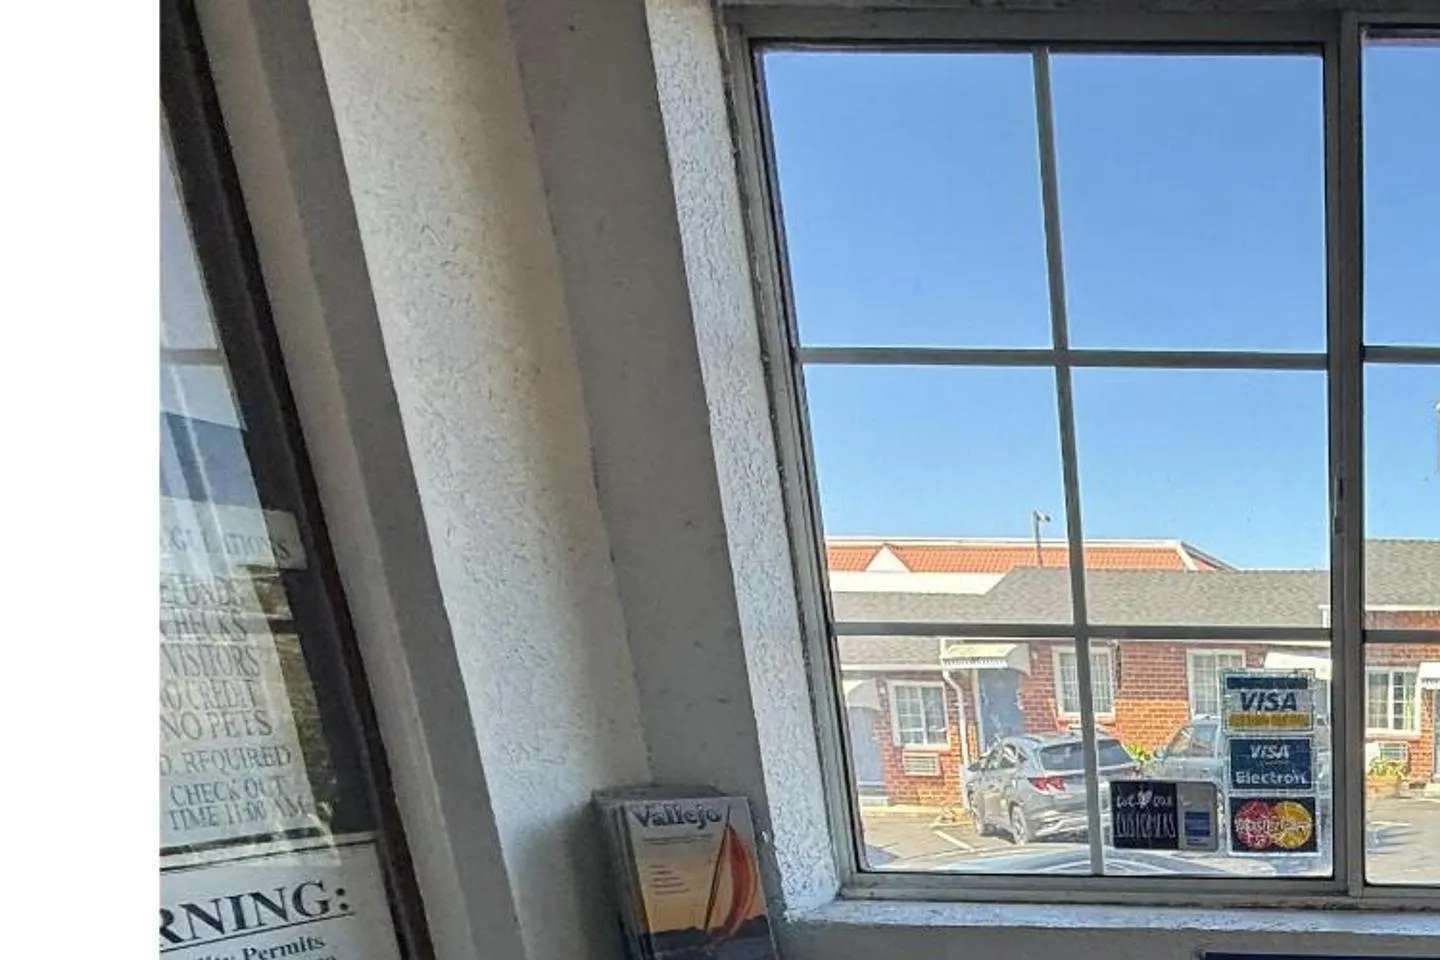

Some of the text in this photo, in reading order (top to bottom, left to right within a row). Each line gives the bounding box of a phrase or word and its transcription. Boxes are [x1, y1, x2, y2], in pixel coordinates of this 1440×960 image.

[160, 643, 261, 678] VISITORS
[1240, 691, 1297, 711] VISA
[160, 710, 273, 741] NO PETS
[182, 745, 292, 774] REQUIRED
[1249, 743, 1290, 759] VISA
[1236, 770, 1306, 784] Electron
[170, 779, 241, 807] CHECK
[168, 806, 219, 830] TIME
[631, 804, 723, 830] Vallejo
